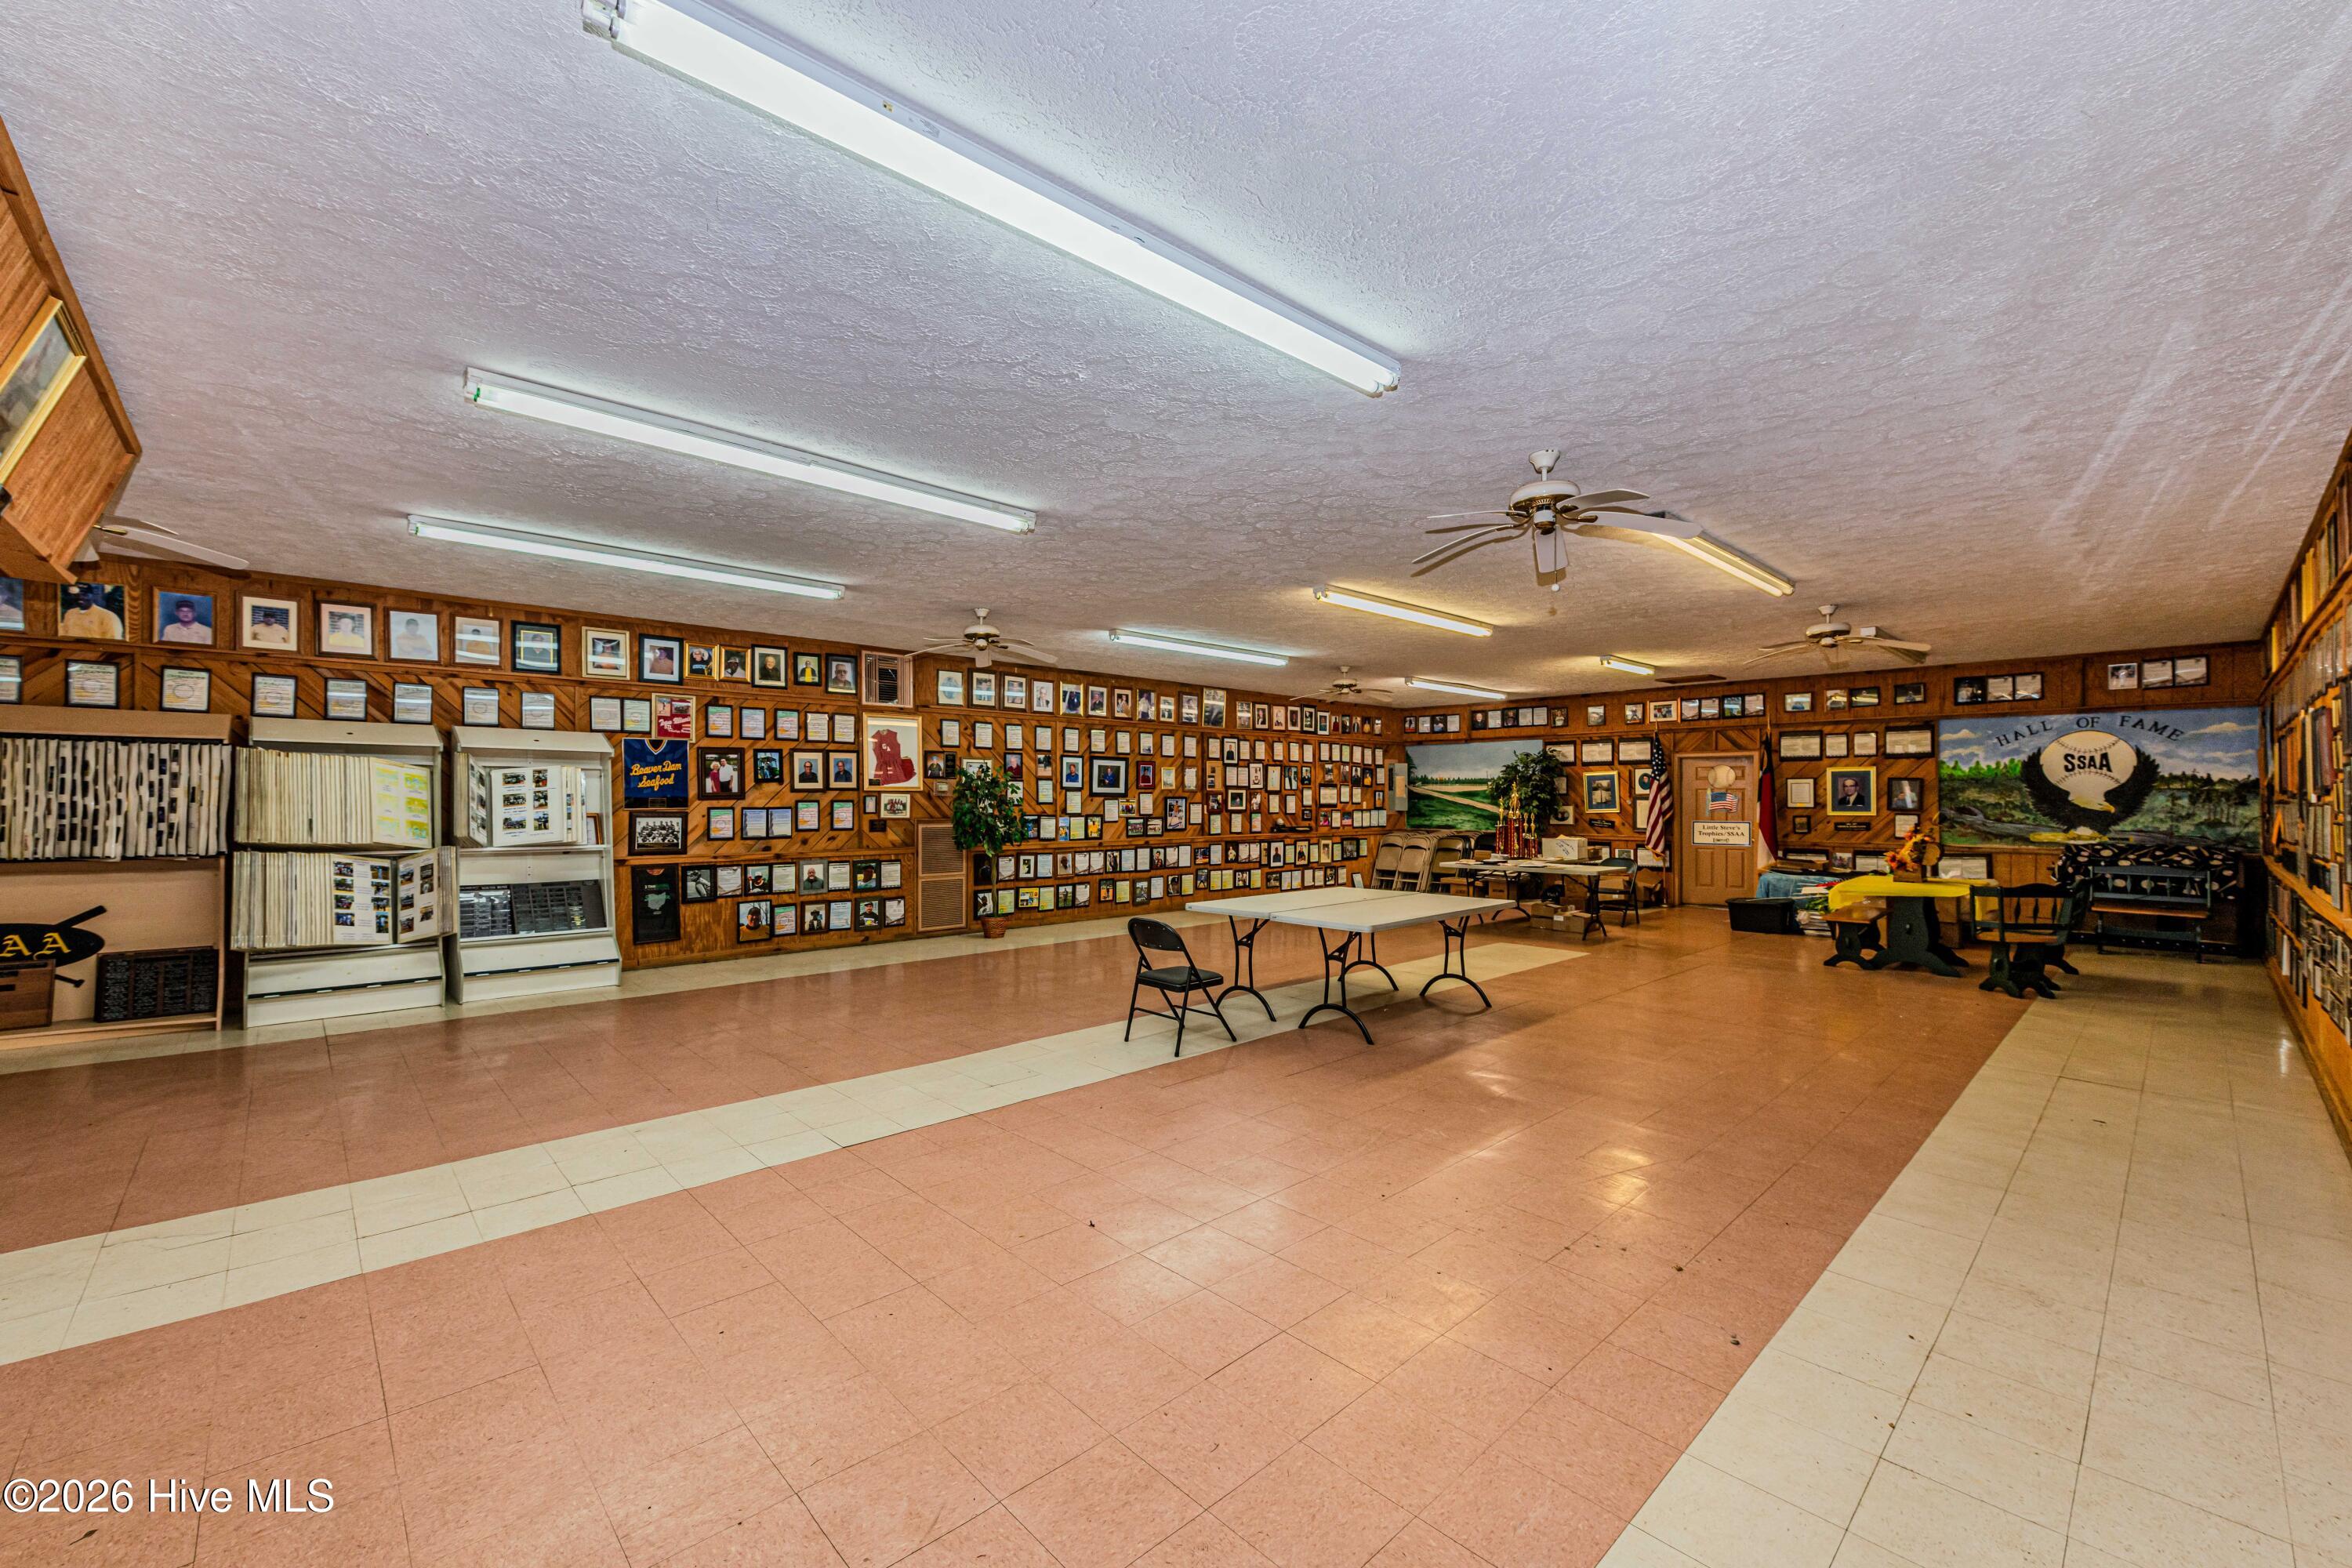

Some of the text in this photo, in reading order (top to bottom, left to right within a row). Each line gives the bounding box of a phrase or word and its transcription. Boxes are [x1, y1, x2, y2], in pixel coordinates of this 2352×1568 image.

[1995, 715, 2184, 746] HALL OF FAME
[630, 760, 682, 775] Beaver Dam
[2063, 752, 2113, 773] SSAA
[637, 773, 675, 791] Seafood
